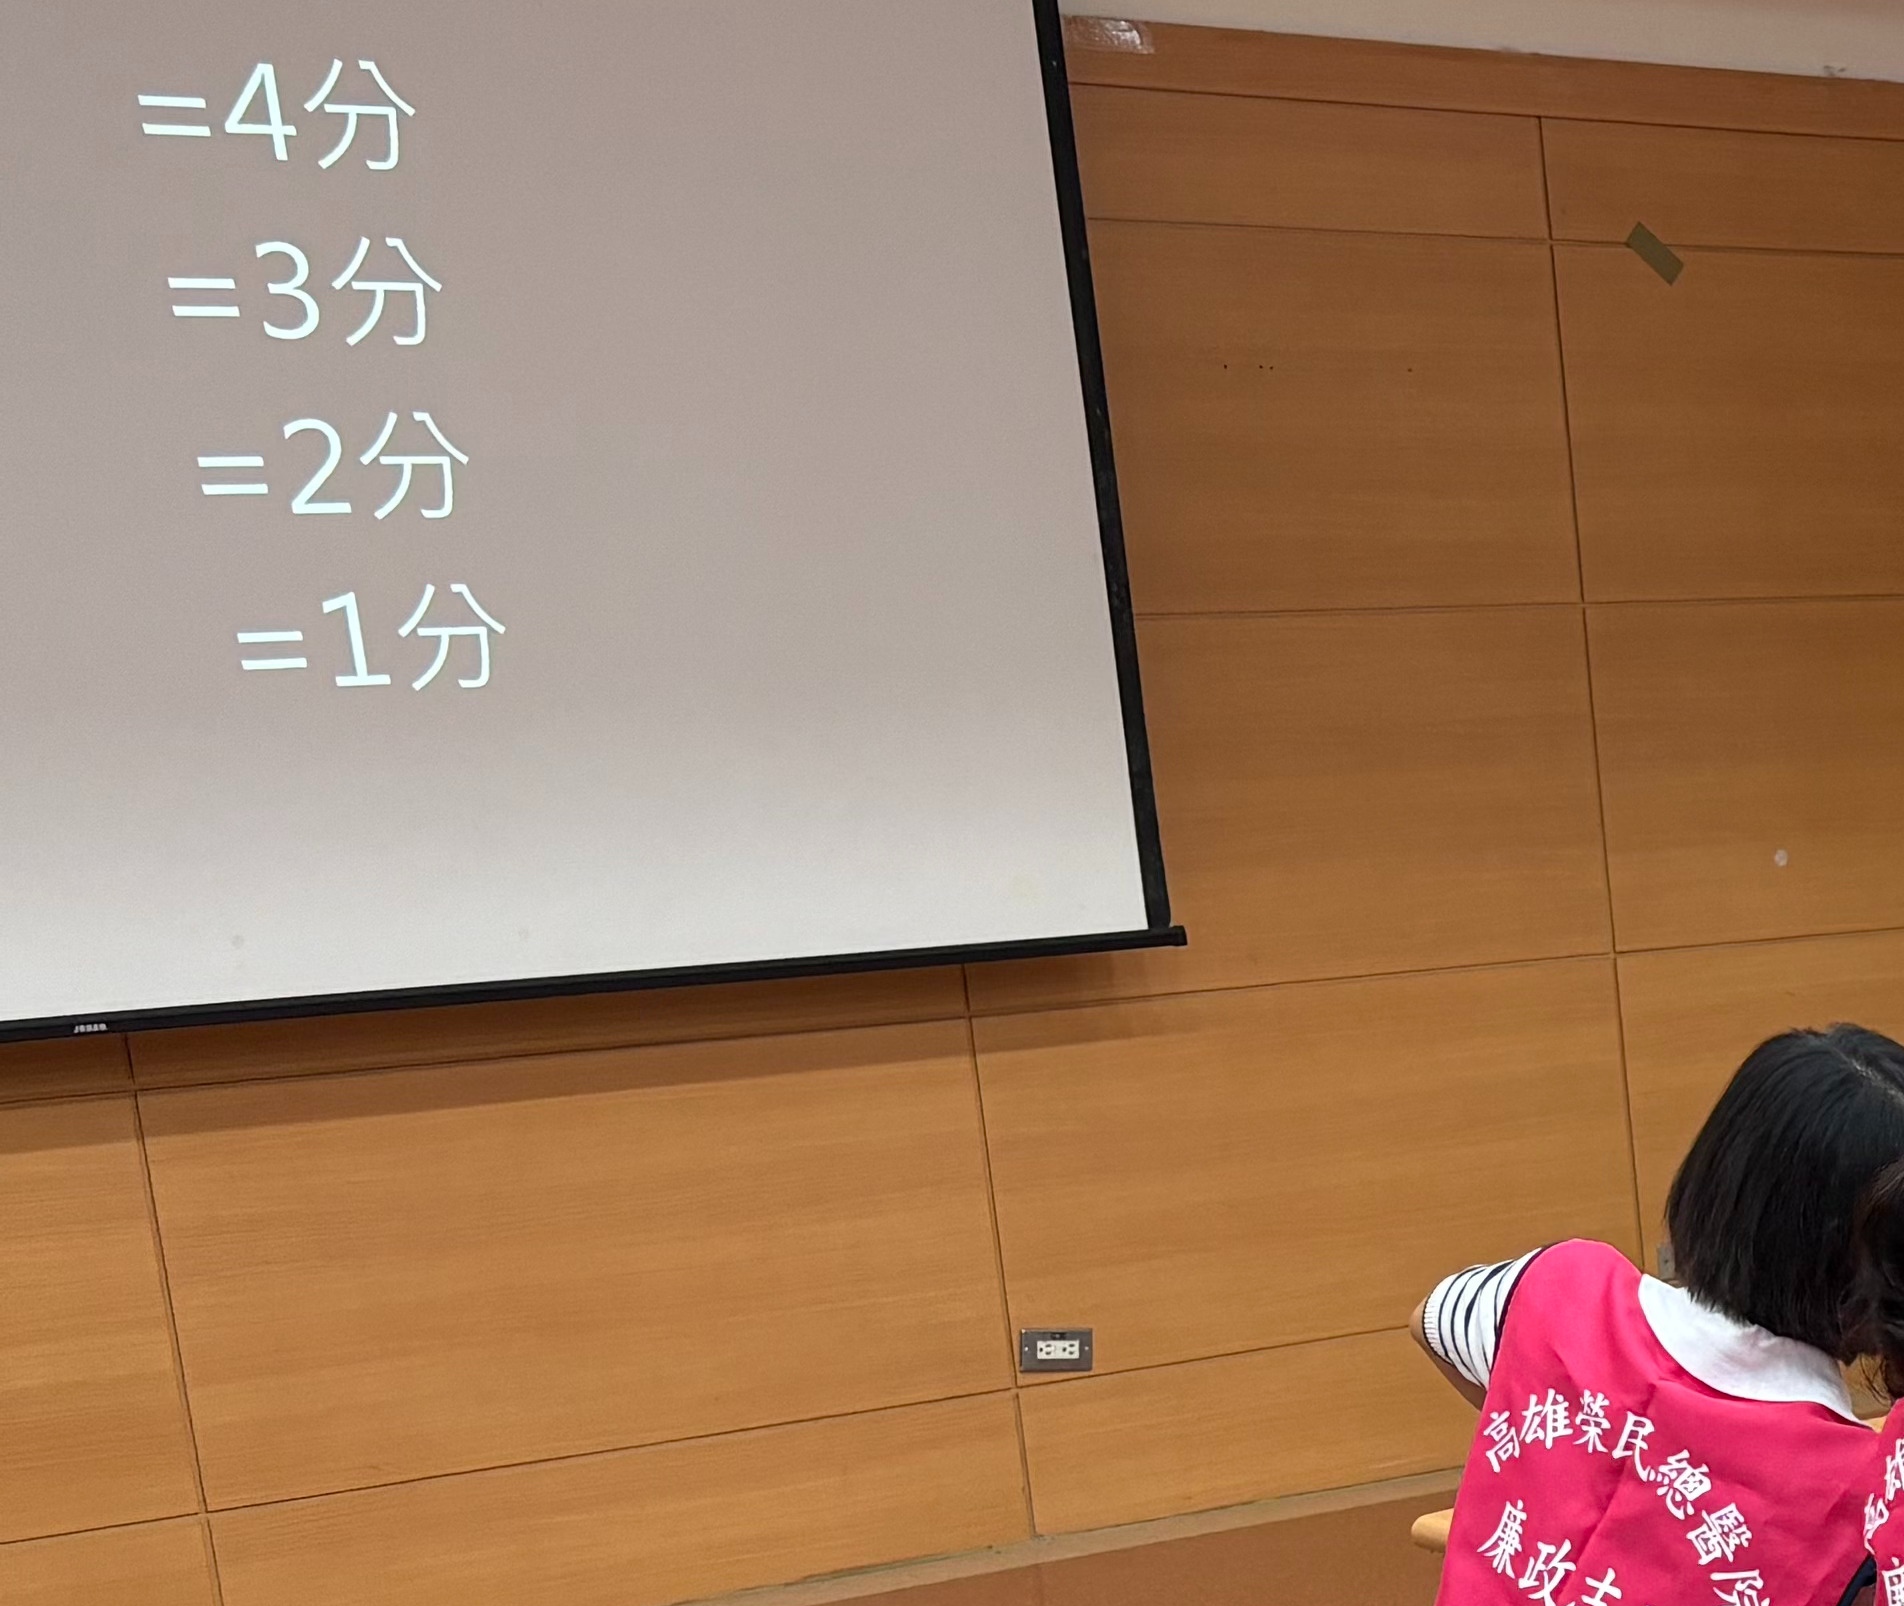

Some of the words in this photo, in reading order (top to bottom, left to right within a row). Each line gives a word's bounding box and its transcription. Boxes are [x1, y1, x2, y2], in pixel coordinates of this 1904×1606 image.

[137, 58, 416, 171] =4分
[167, 236, 443, 347] =3分
[196, 410, 470, 521] =2分
[236, 582, 506, 692] =1分
